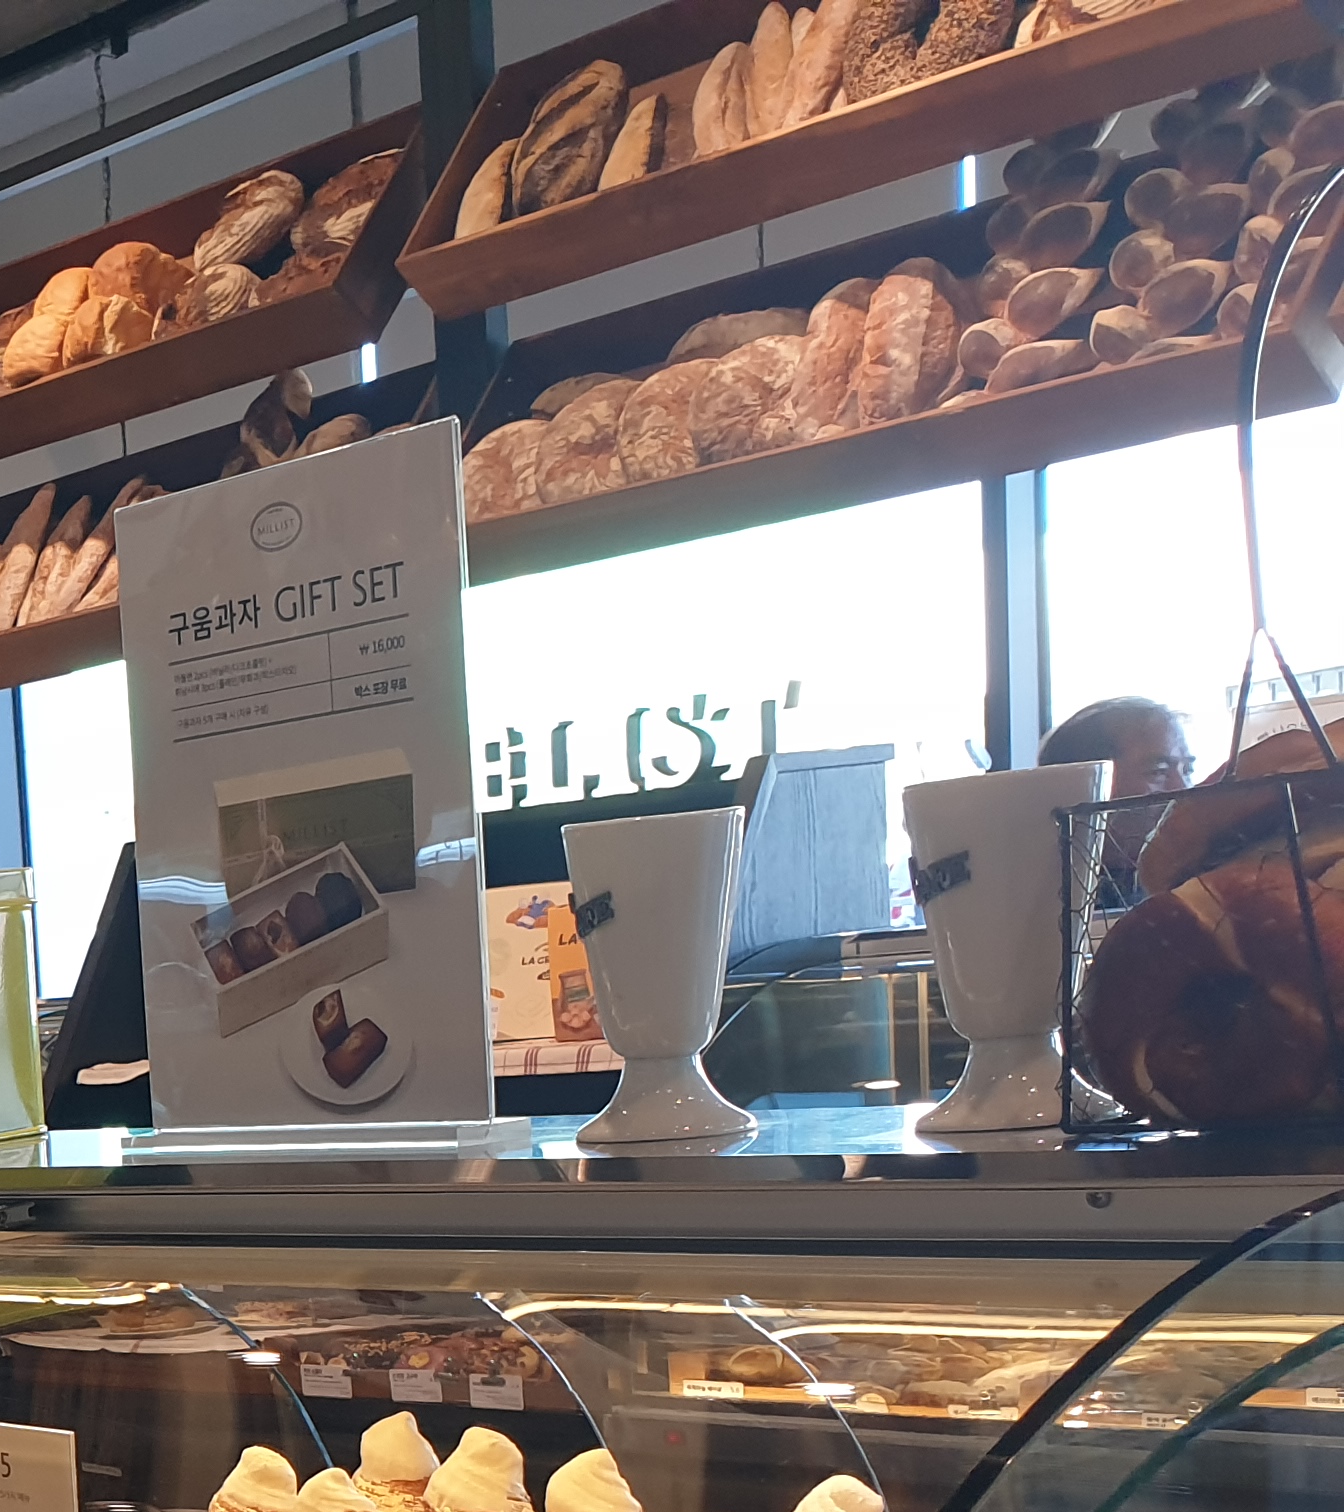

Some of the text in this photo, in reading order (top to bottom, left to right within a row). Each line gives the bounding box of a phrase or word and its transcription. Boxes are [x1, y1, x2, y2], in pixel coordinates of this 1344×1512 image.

[256, 517, 296, 538] MILLIST
[168, 560, 405, 647] 구움과자 GIFT SET
[371, 634, 406, 657] 16,000
[390, 677, 408, 692] 무료
[0, 1452, 12, 1479] 5
